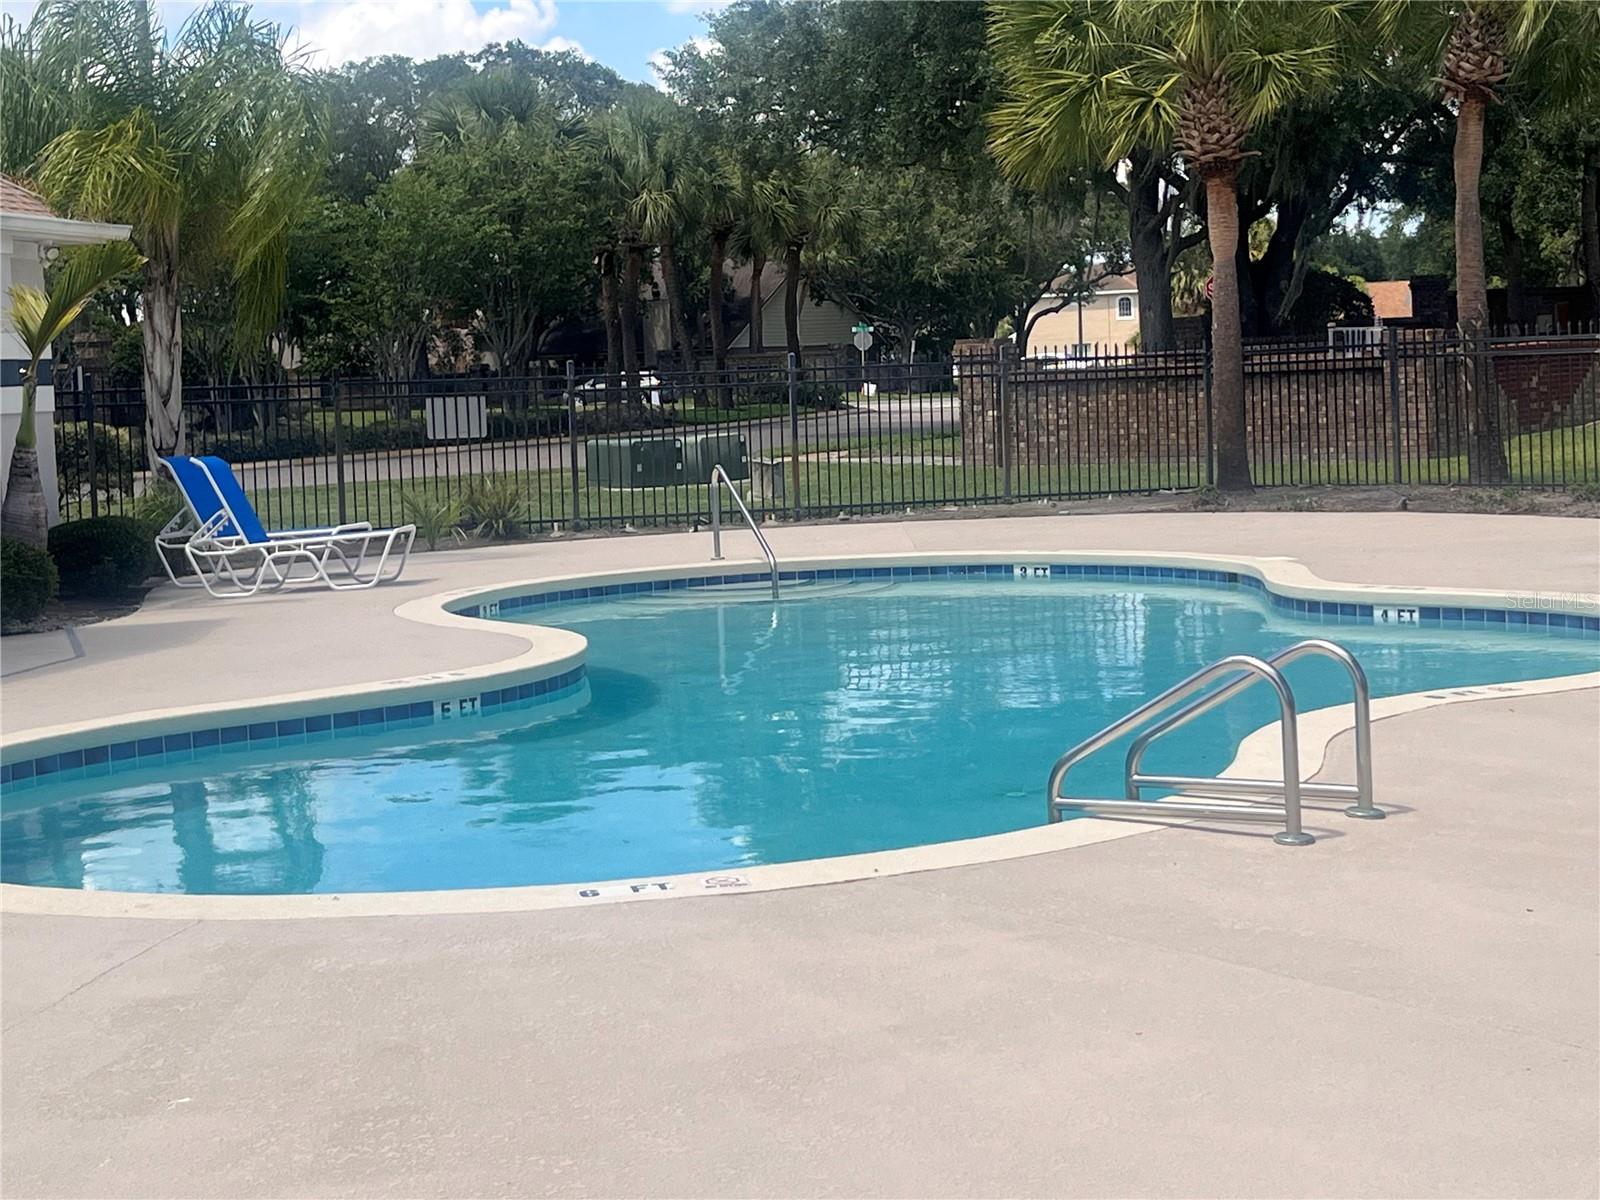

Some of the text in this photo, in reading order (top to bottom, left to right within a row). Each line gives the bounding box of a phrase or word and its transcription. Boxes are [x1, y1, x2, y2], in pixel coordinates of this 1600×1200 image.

[1397, 608, 1416, 620] FT
[459, 697, 478, 711] FT
[579, 882, 670, 897] 6 FT
